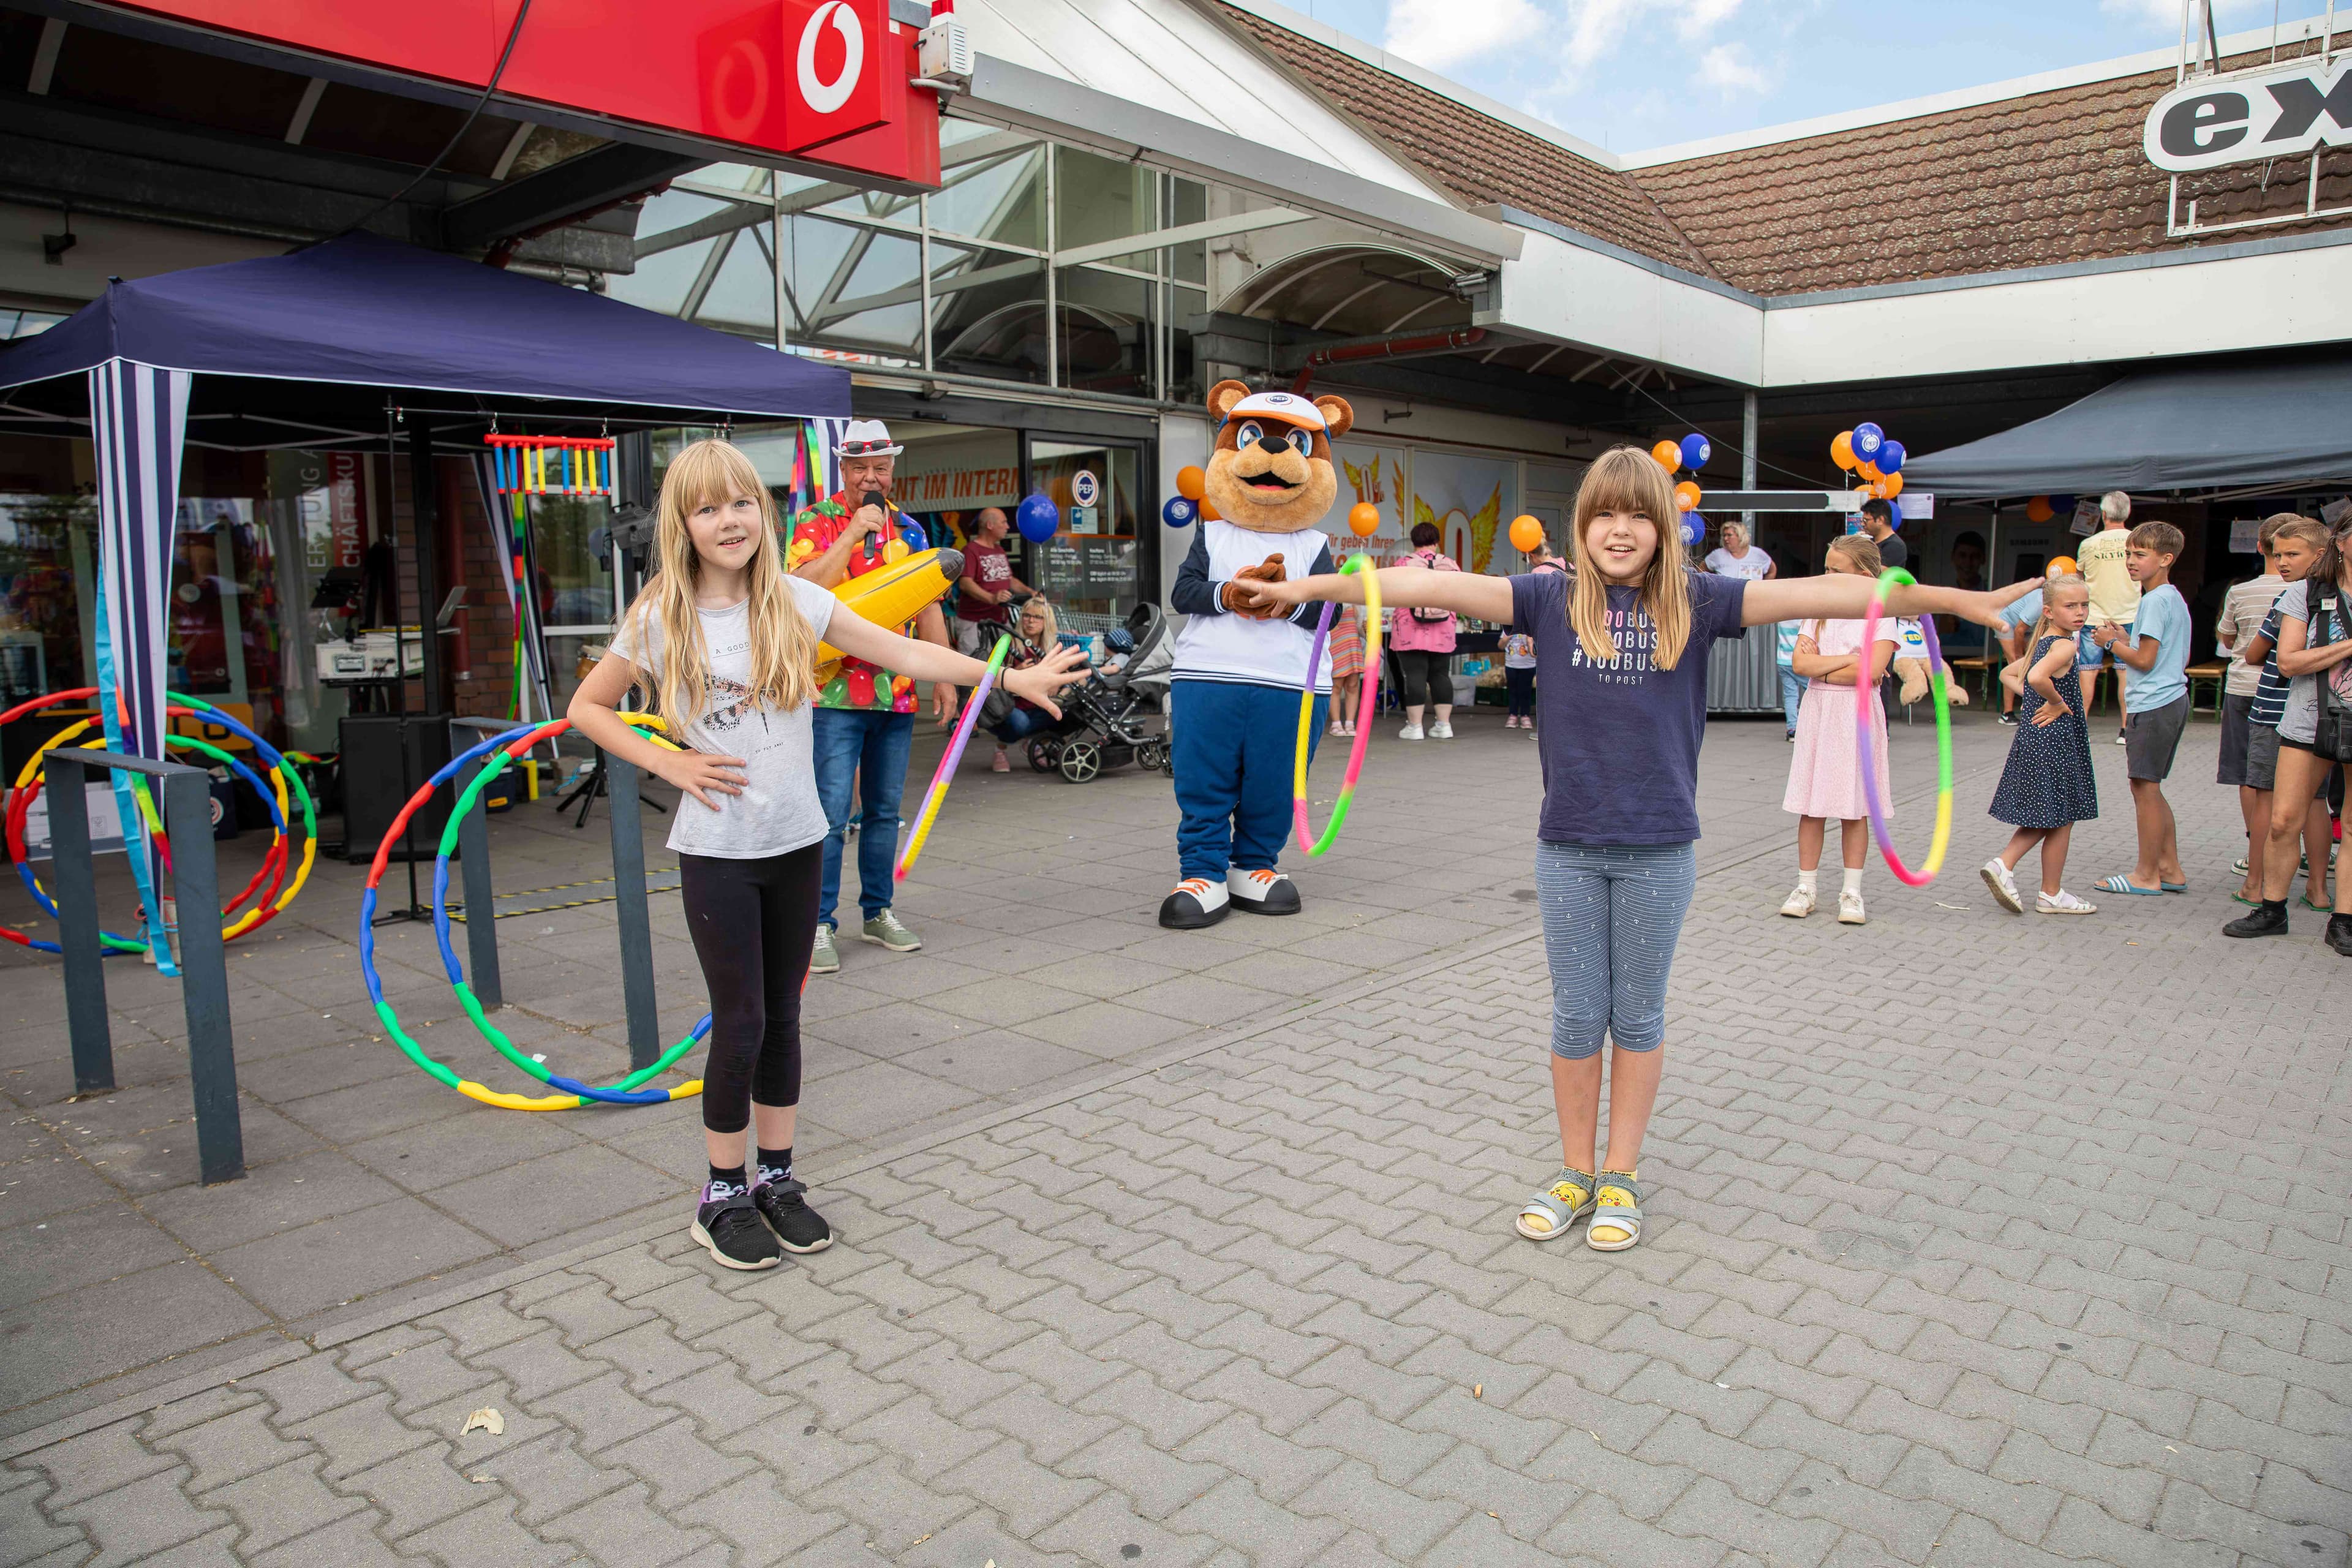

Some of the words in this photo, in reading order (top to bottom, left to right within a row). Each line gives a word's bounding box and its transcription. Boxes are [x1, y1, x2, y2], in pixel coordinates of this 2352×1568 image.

[2160, 69, 2352, 157] ex
[923, 472, 947, 500] IM
[1078, 483, 1093, 494] PEP
[1341, 533, 1369, 551] geben
[727, 642, 750, 652] GOOD
[1599, 674, 1611, 684] TO
[1616, 676, 1643, 685] POST
